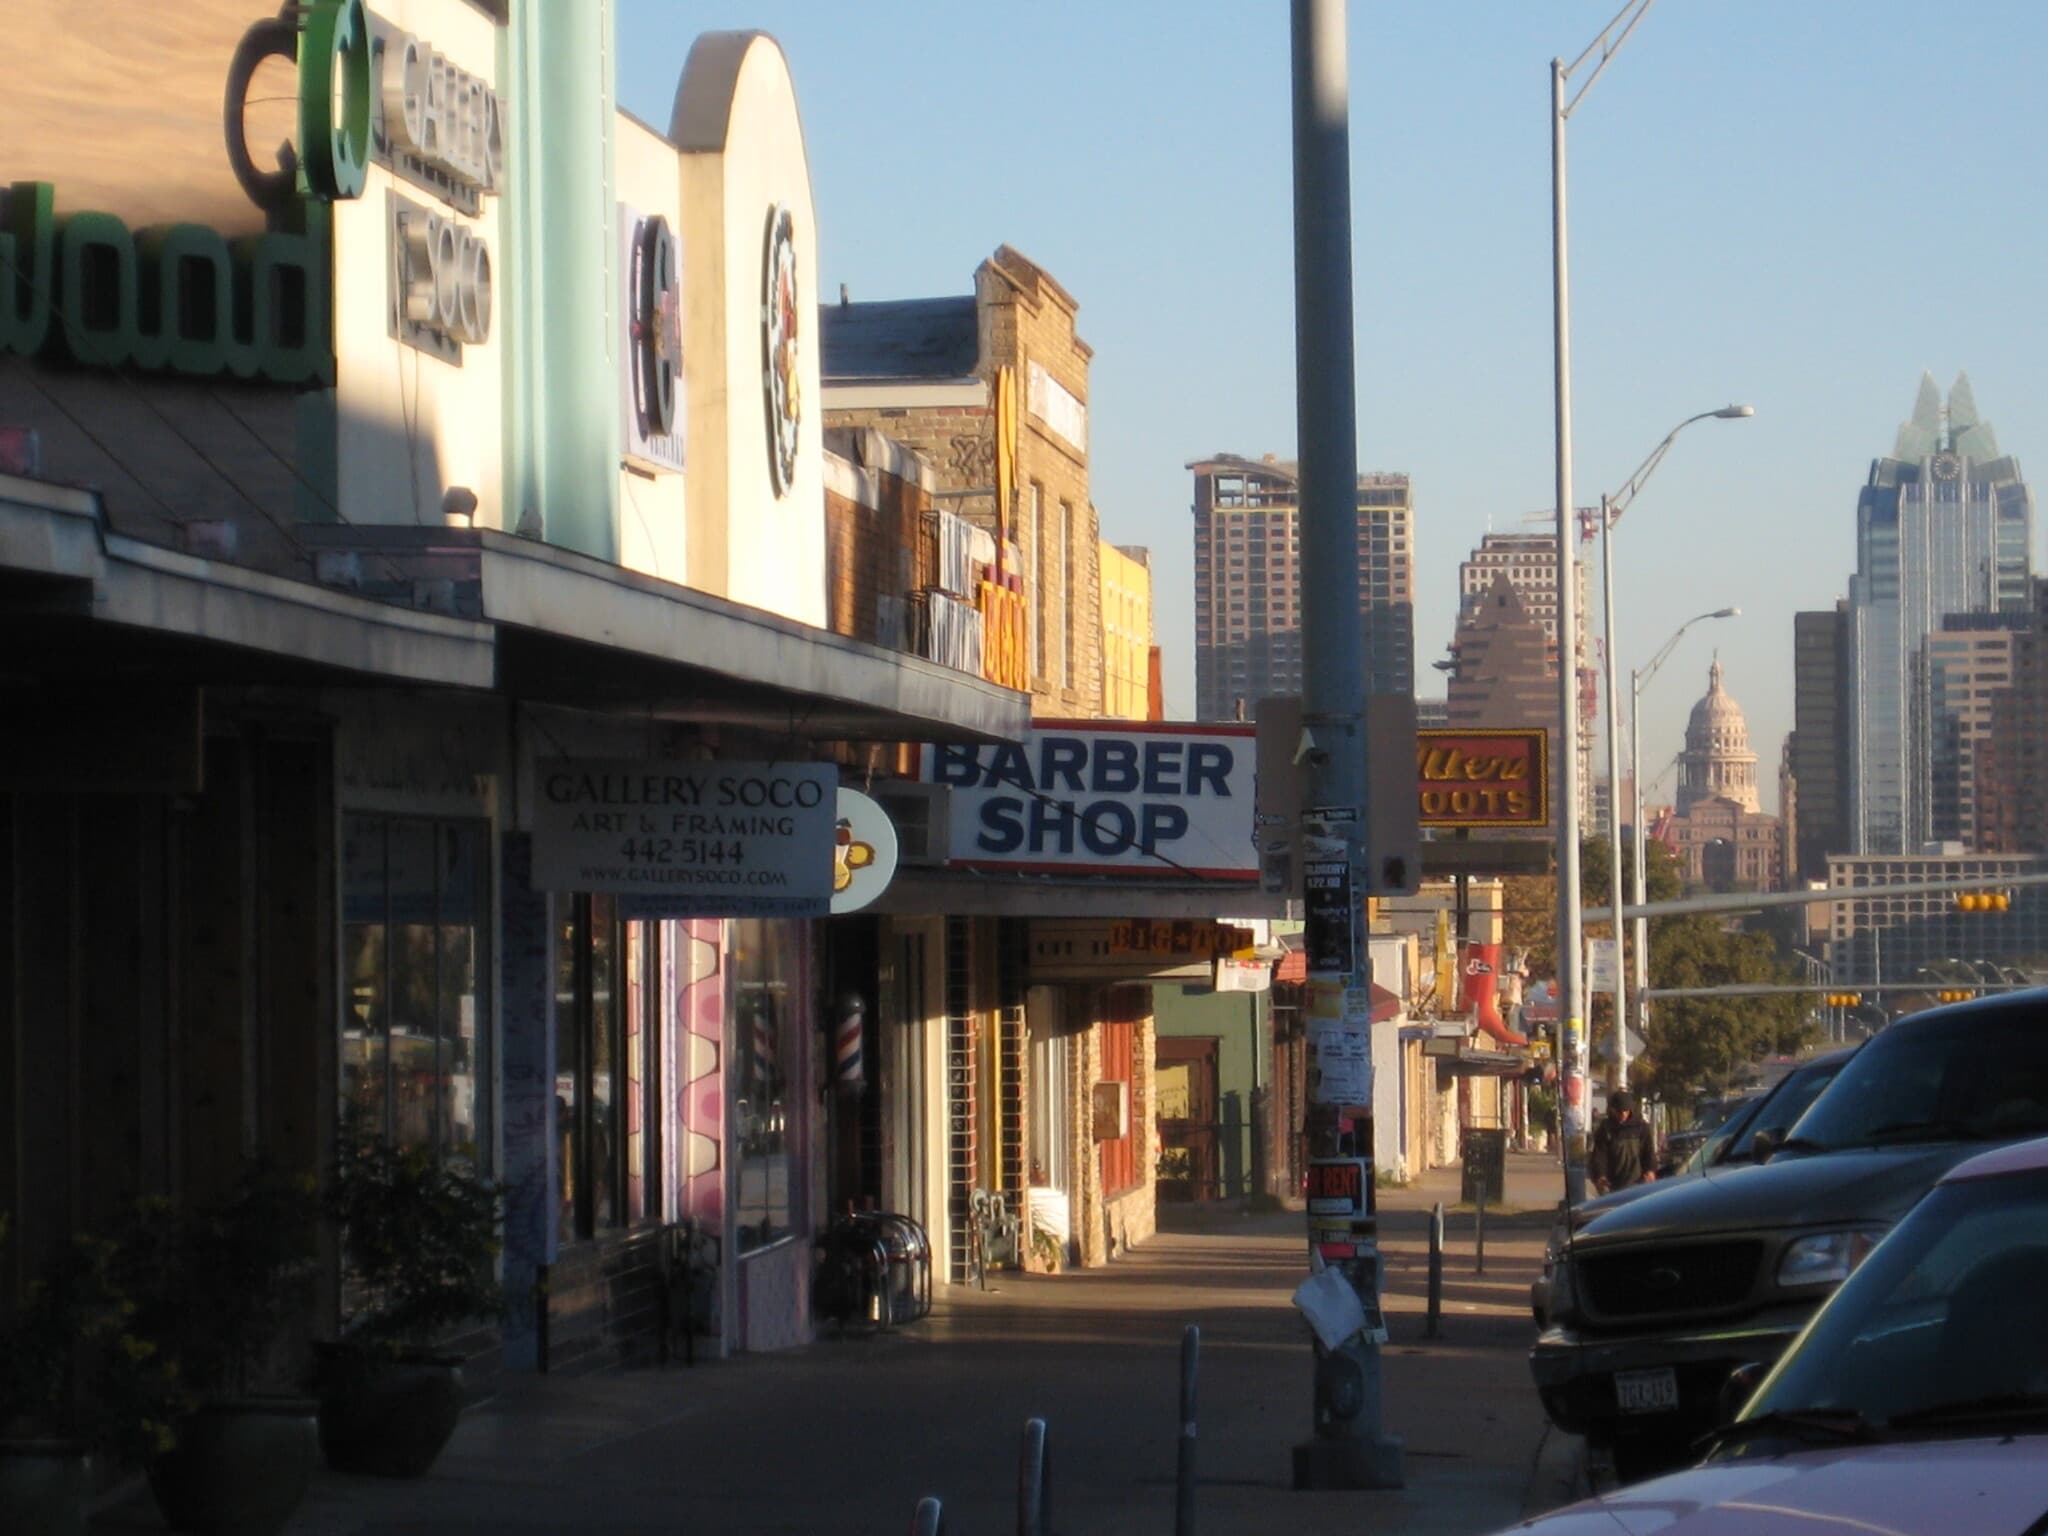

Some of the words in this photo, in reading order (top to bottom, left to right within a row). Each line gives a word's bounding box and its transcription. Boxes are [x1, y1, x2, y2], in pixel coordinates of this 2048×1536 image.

[932, 736, 1234, 797] BARBER
[546, 774, 708, 806] GALLERY
[717, 776, 823, 809] SOCO
[1417, 789, 1531, 814] OOTS
[572, 813, 630, 833] ART
[639, 814, 656, 833] &
[671, 815, 794, 836] FRAMING
[976, 796, 1189, 857] SHOP
[580, 867, 788, 887] WWW.GALLERYSOCO.COM
